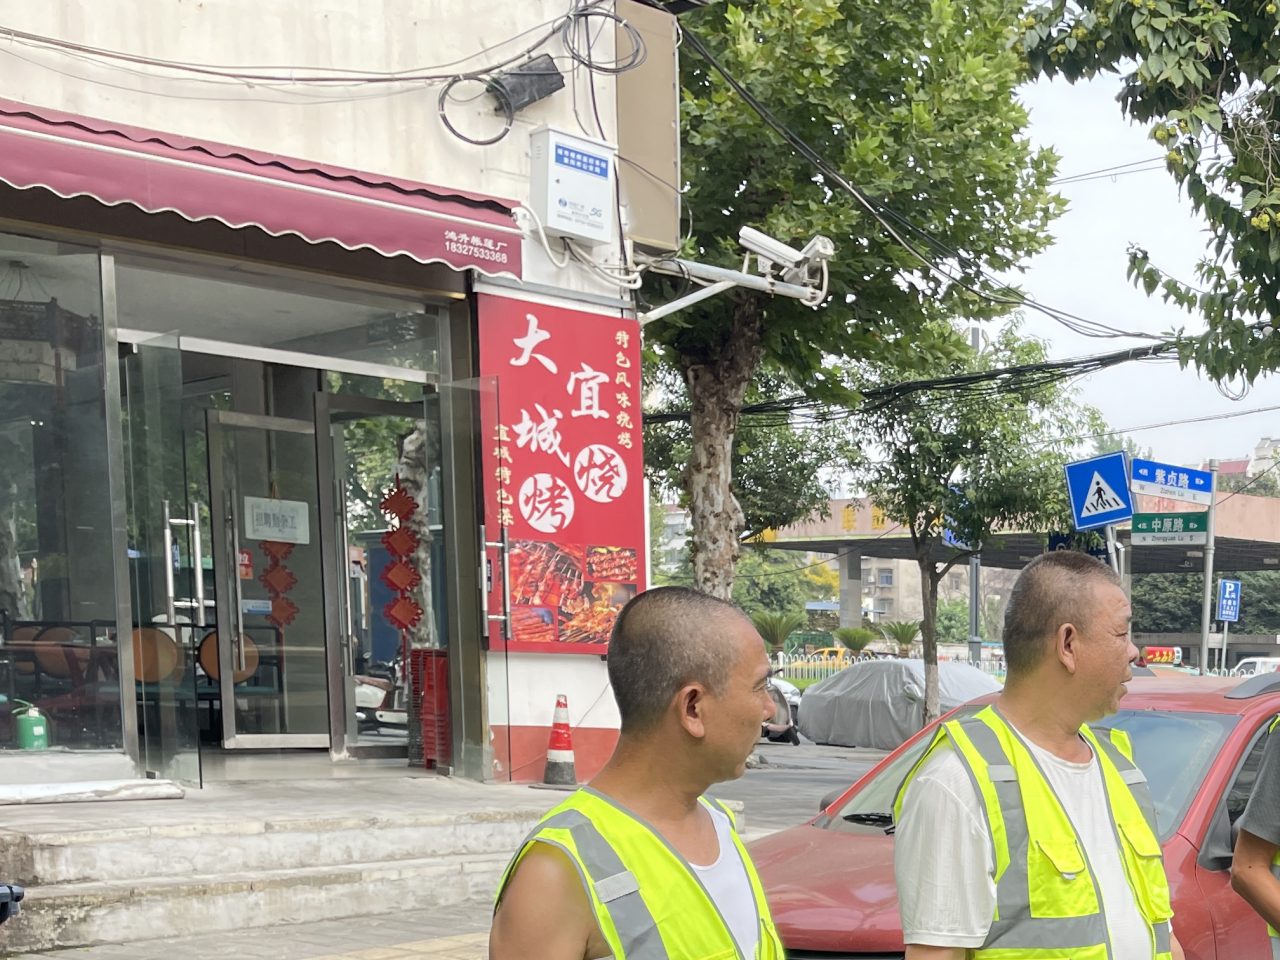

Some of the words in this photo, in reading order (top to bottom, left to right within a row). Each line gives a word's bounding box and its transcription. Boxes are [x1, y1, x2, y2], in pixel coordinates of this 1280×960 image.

[615, 330, 634, 449] 特色风味烧烤
[492, 424, 514, 526] 宜城特色菜
[1155, 468, 1189, 489] 紫贞路
[1151, 518, 1184, 533] 中原路
[1224, 582, 1235, 599] P
